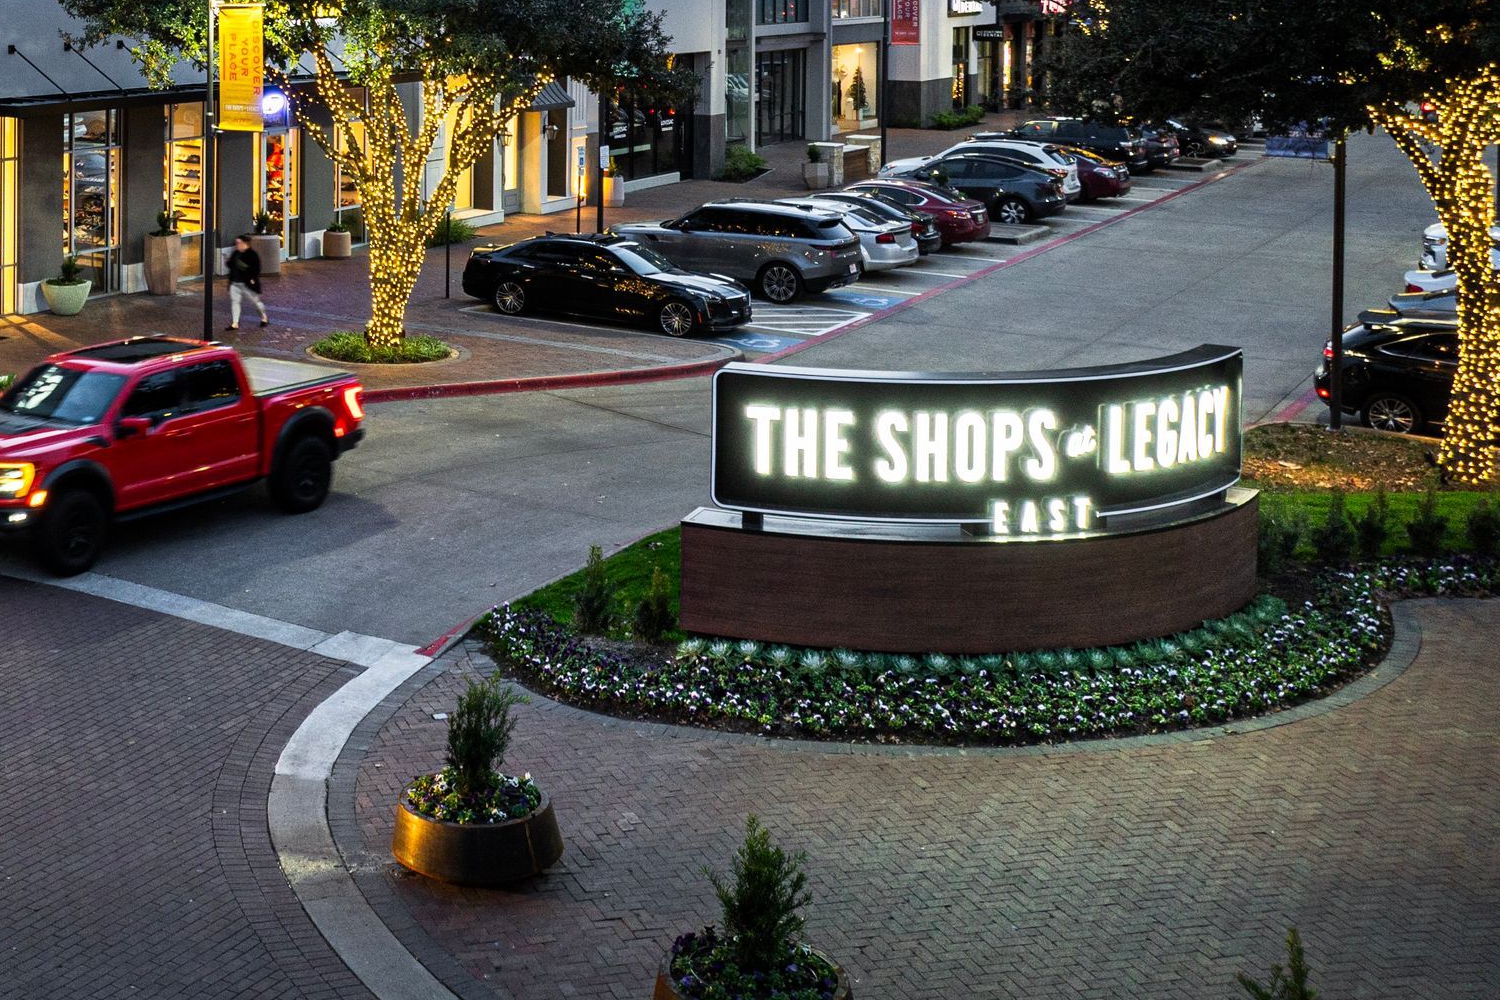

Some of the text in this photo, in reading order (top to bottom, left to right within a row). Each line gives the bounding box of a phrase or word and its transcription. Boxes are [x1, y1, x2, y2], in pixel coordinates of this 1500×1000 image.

[228, 33, 238, 81] PLACE
[241, 38, 249, 78] YOUR
[252, 20, 261, 96] DISCOVER
[744, 384, 1231, 483] THE SHOPS at LEGACY
[992, 498, 1093, 534] EAST
